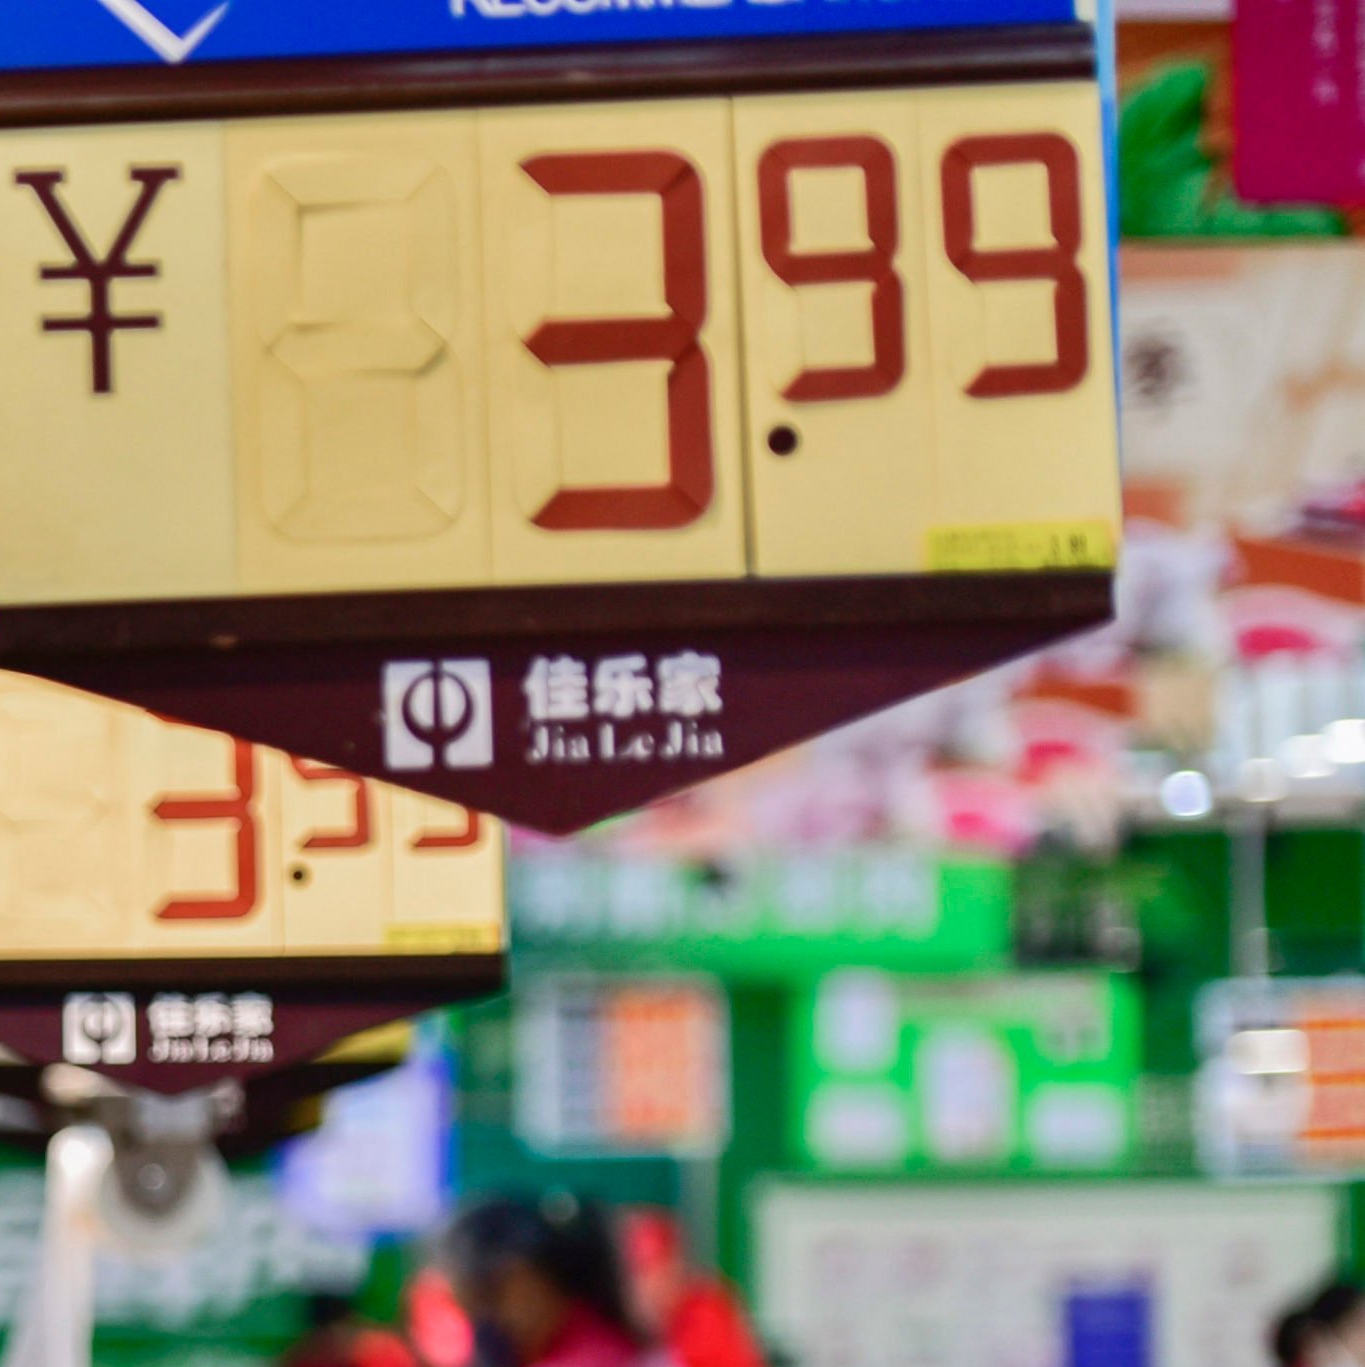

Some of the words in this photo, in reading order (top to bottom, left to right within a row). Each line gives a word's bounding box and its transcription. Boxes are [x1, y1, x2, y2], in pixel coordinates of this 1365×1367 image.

[518, 131, 1090, 532] 3.99
[523, 649, 724, 720] 佳乐家
